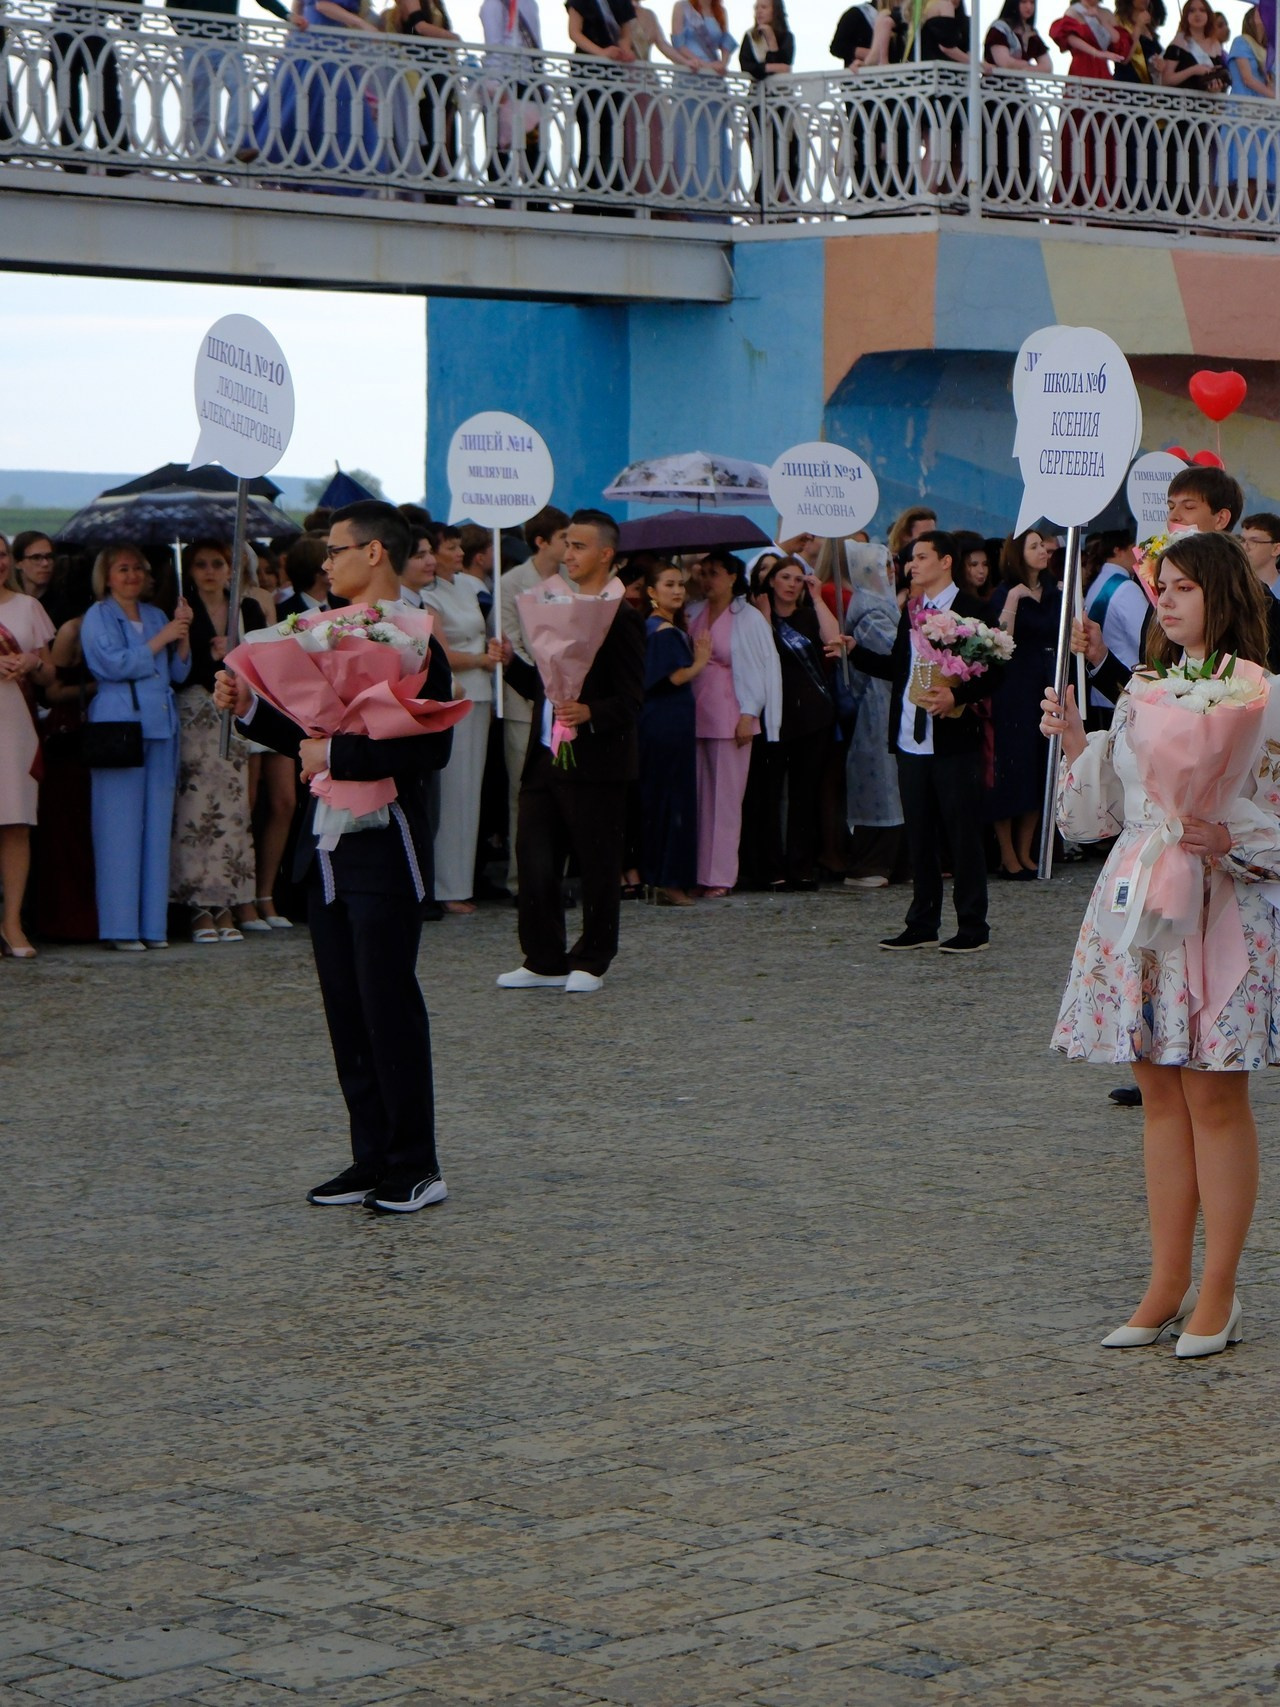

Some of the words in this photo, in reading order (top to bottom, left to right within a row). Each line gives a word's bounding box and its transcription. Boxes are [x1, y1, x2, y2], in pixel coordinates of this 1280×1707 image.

[207, 336, 252, 374] ШКОЛА
[255, 354, 284, 386] №10
[1043, 372, 1083, 394] ШКОЛА
[1085, 362, 1107, 394] №6
[216, 375, 269, 415] ЛЮДМИЛА
[200, 400, 282, 451] АЛЕКСАНДРОВНА
[1051, 411, 1100, 437] КСЕНИЯ
[459, 431, 502, 452] ЛИЦЕЙ
[506, 436, 533, 452] №14
[468, 466, 519, 479] МИЛЯУША
[781, 460, 831, 479] ЛИЦЕЙ
[834, 464, 862, 481] №31
[1039, 449, 1105, 477] СЕРГЕЕВНА
[462, 492, 536, 506] САЛЬМАНОВНА
[804, 482, 845, 498] АЙГУЛЬ
[797, 503, 856, 518] АНАСОВНА
